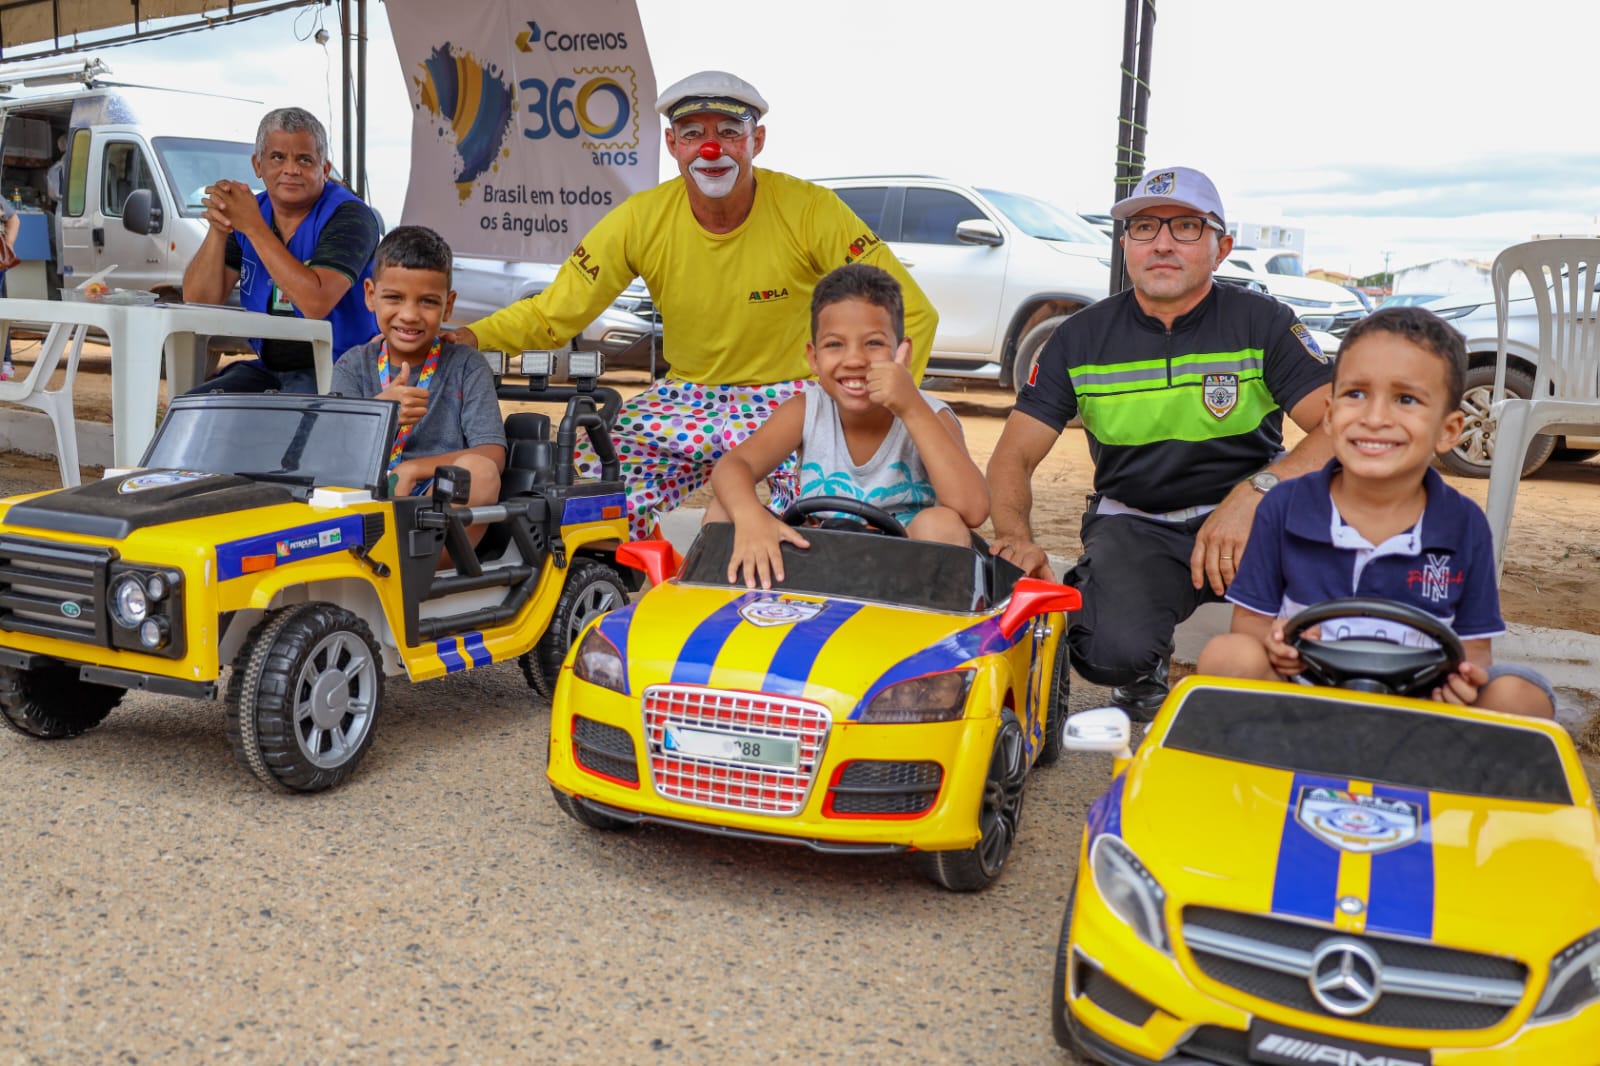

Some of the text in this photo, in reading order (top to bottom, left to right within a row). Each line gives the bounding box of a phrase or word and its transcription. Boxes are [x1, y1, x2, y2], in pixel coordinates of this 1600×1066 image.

[544, 30, 628, 51] Correios
[519, 76, 630, 139] 360
[592, 151, 638, 166] anos
[483, 184, 613, 205] Brasil em todos
[480, 211, 569, 236] os ângulos
[572, 245, 600, 281] PLA
